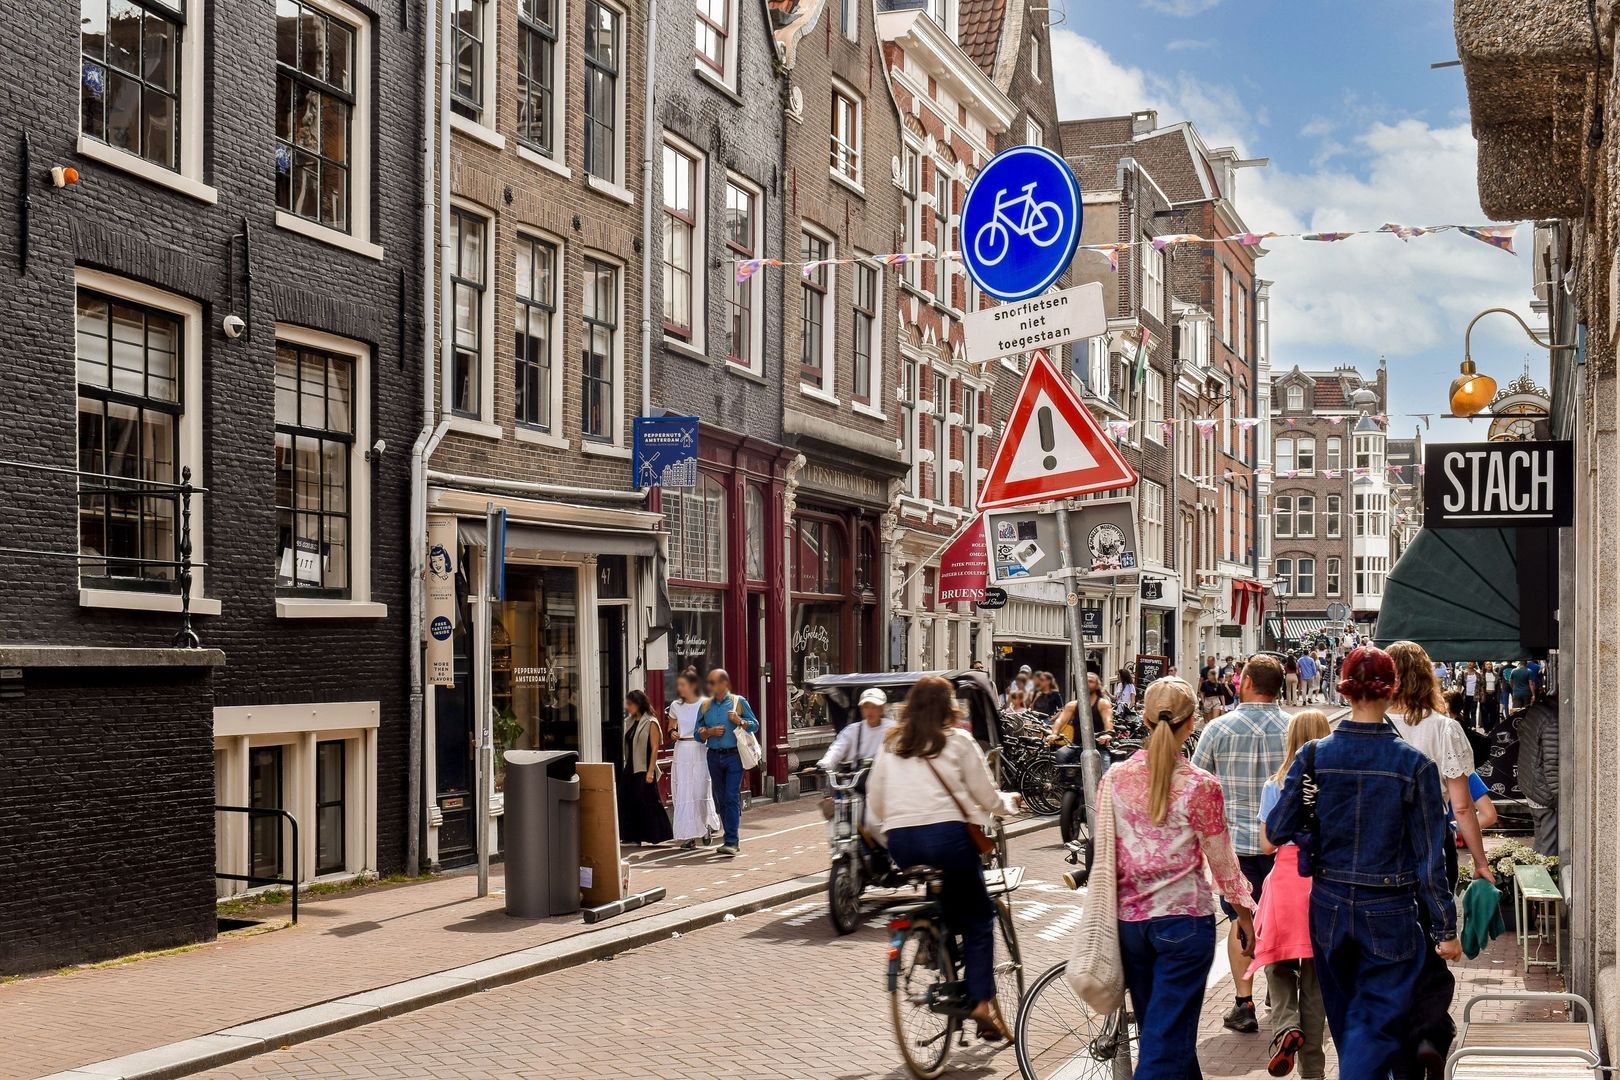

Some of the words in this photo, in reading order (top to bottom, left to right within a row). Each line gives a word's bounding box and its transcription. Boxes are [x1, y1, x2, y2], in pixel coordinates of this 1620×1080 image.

[994, 296, 1068, 321] snorfietsen
[1020, 316, 1046, 330] niet
[998, 327, 1071, 350] toegestaan
[1443, 450, 1554, 512] STACH
[601, 567, 611, 585] 47
[941, 588, 985, 600] BRUENS
[515, 675, 546, 683] AMSTERDAM
